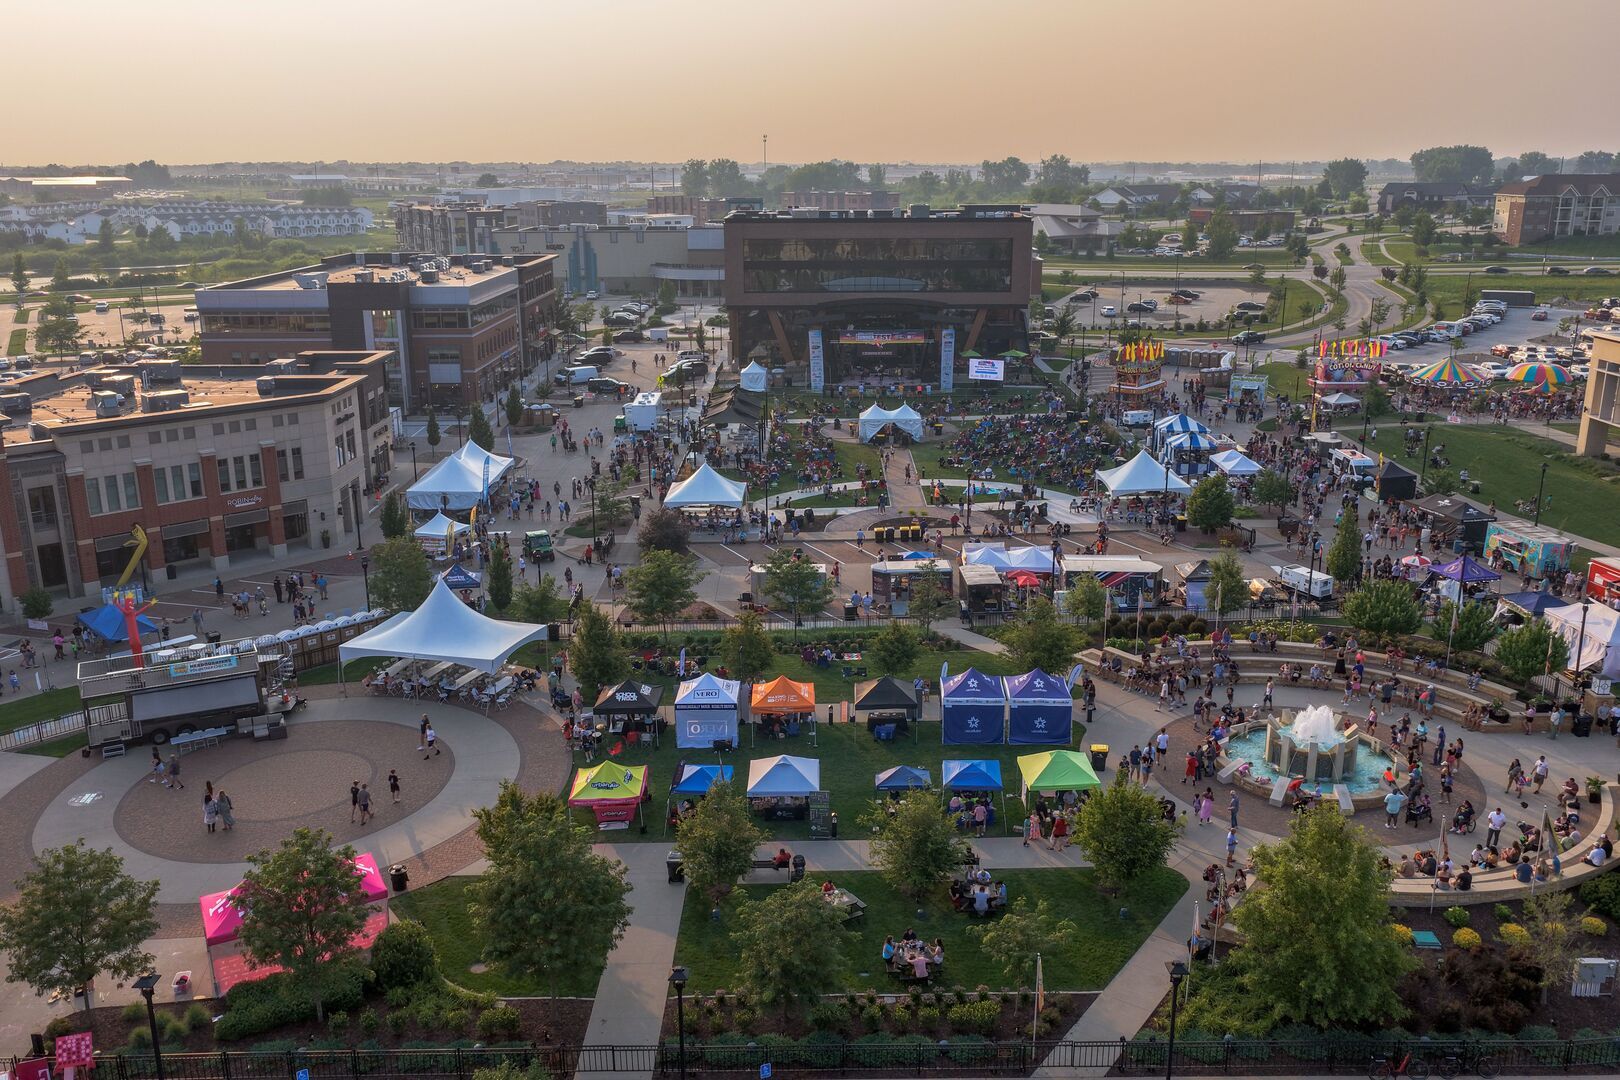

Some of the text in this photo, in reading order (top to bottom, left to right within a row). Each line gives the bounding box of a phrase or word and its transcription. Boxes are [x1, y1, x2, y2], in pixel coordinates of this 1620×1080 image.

[1329, 362, 1376, 371] COTTON CANDY
[695, 690, 718, 698] VERO
